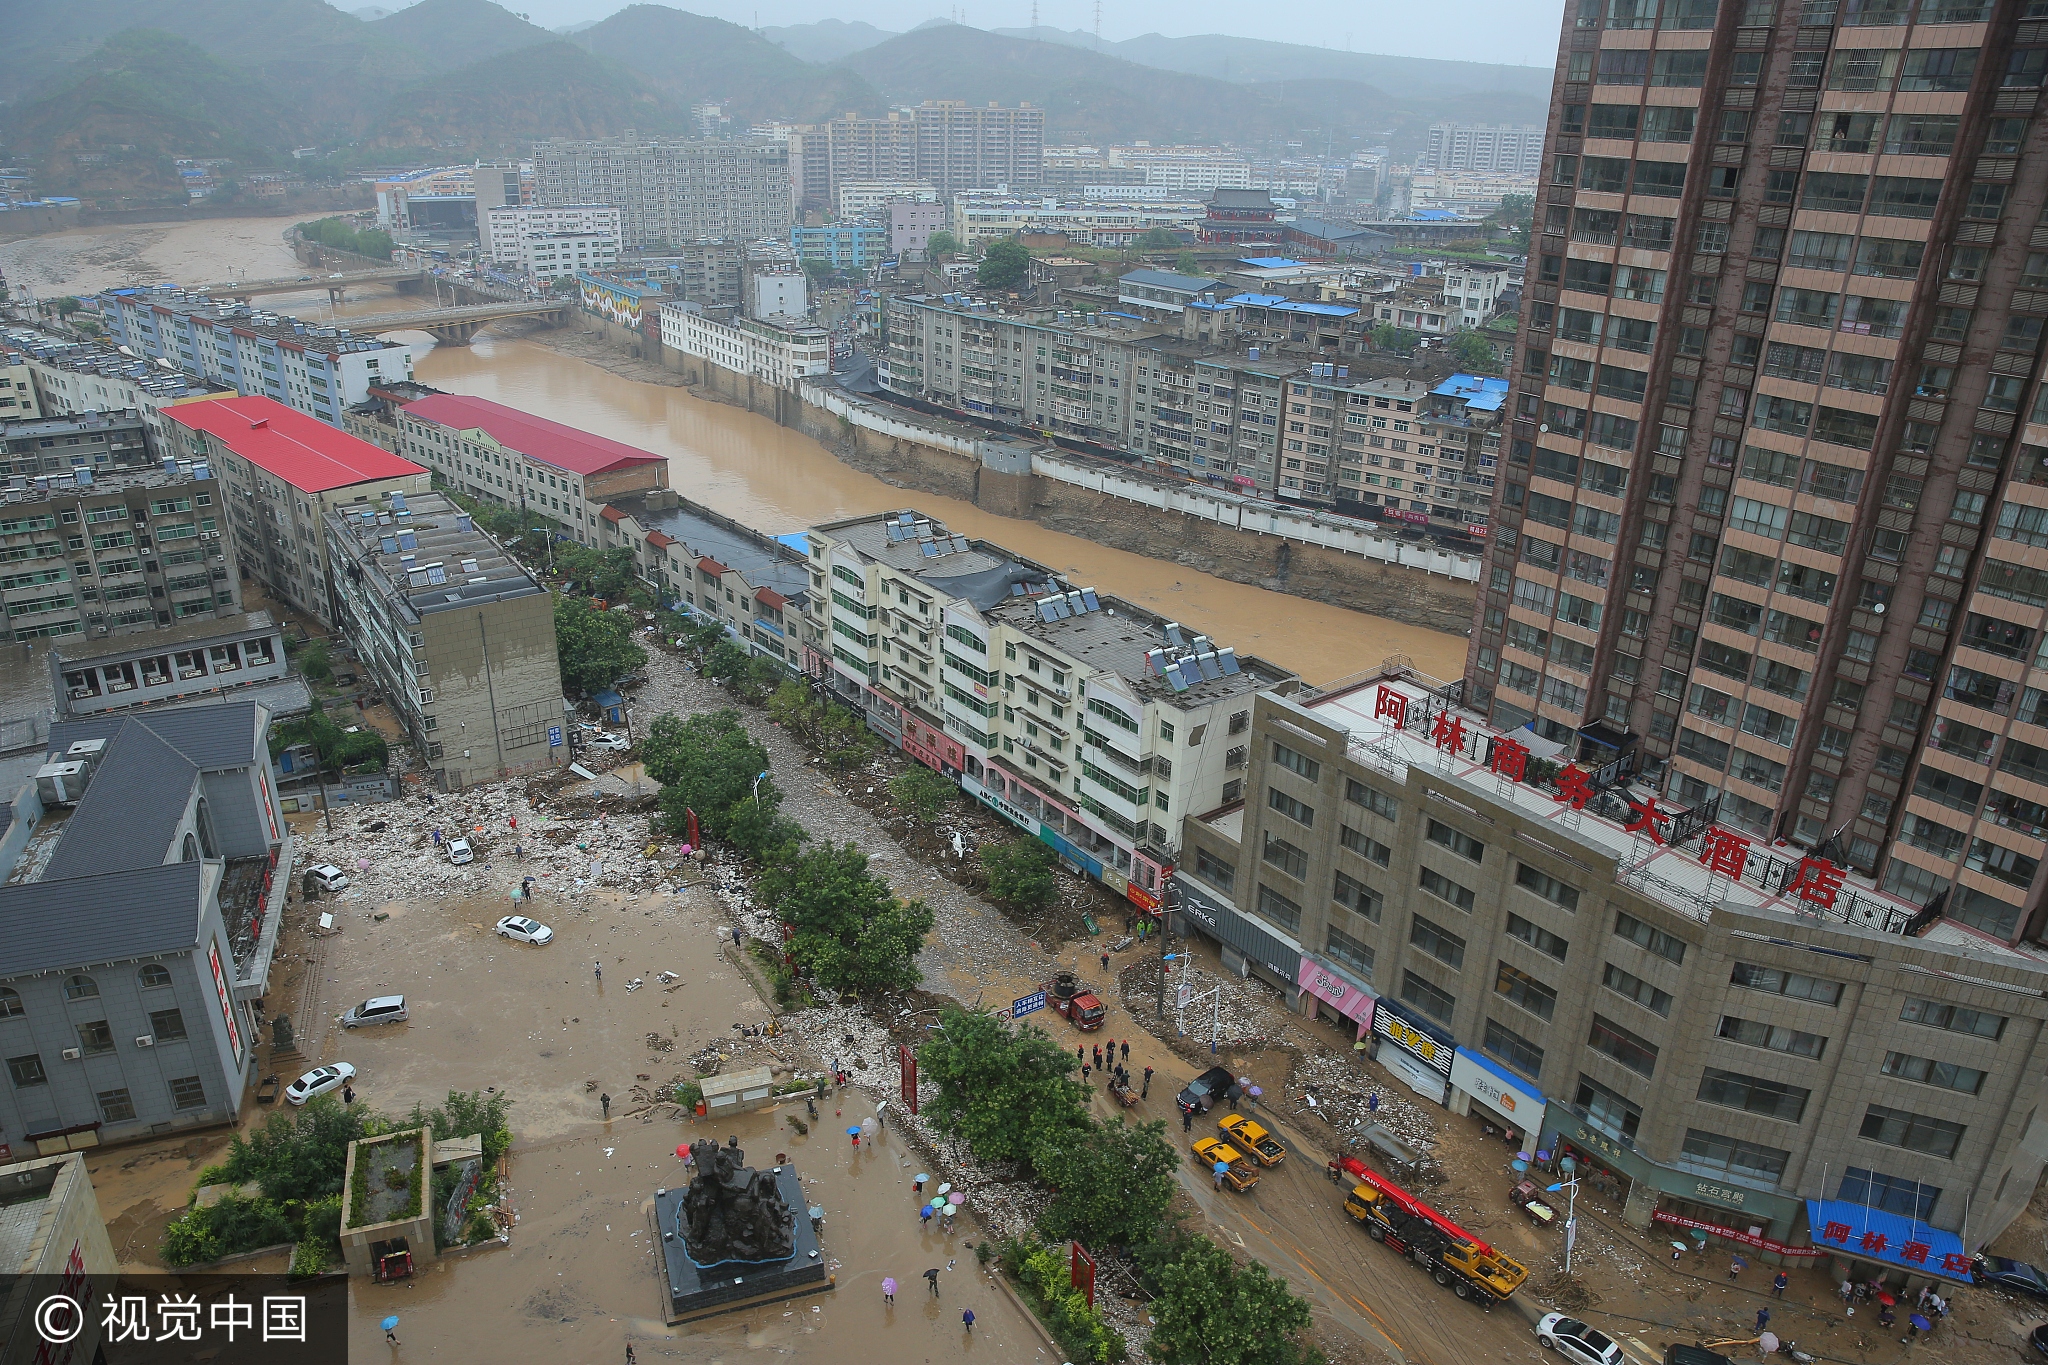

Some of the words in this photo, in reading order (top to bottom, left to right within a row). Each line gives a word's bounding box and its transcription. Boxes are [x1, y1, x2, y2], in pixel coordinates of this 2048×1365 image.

[979, 789, 992, 802] ABC
[1374, 685, 1847, 909] 阿林商务大酒店
[1187, 904, 1217, 927] ERKE
[1360, 1173, 1380, 1188] SANY
[1696, 1182, 1744, 1202] 钻石宫殿
[1823, 1220, 1974, 1275] 阿林酒店
